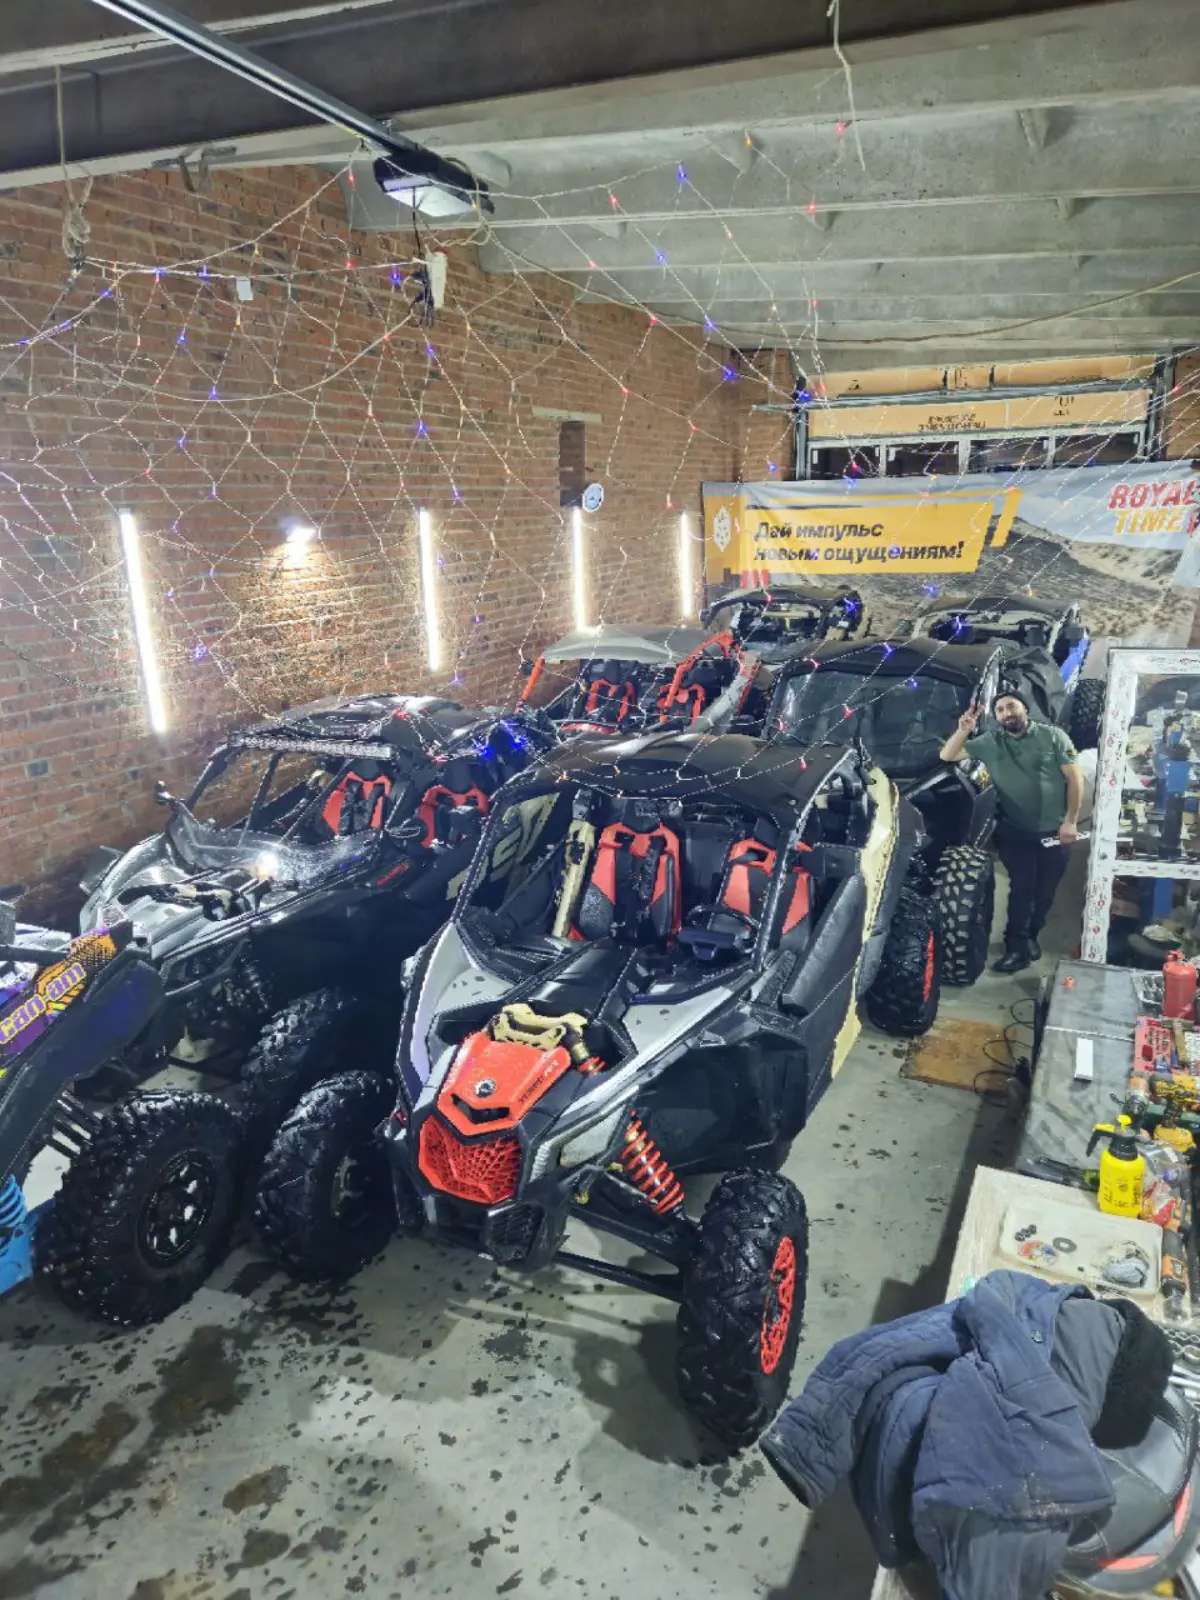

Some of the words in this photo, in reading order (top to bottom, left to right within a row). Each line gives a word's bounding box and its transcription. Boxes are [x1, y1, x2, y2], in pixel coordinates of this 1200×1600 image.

[1108, 479, 1198, 509] ROYAL
[754, 522, 792, 541] Дай
[795, 523, 885, 541] импульс
[1114, 508, 1182, 534] TIME
[754, 547, 819, 561] новым
[824, 541, 965, 564] ощущениям!
